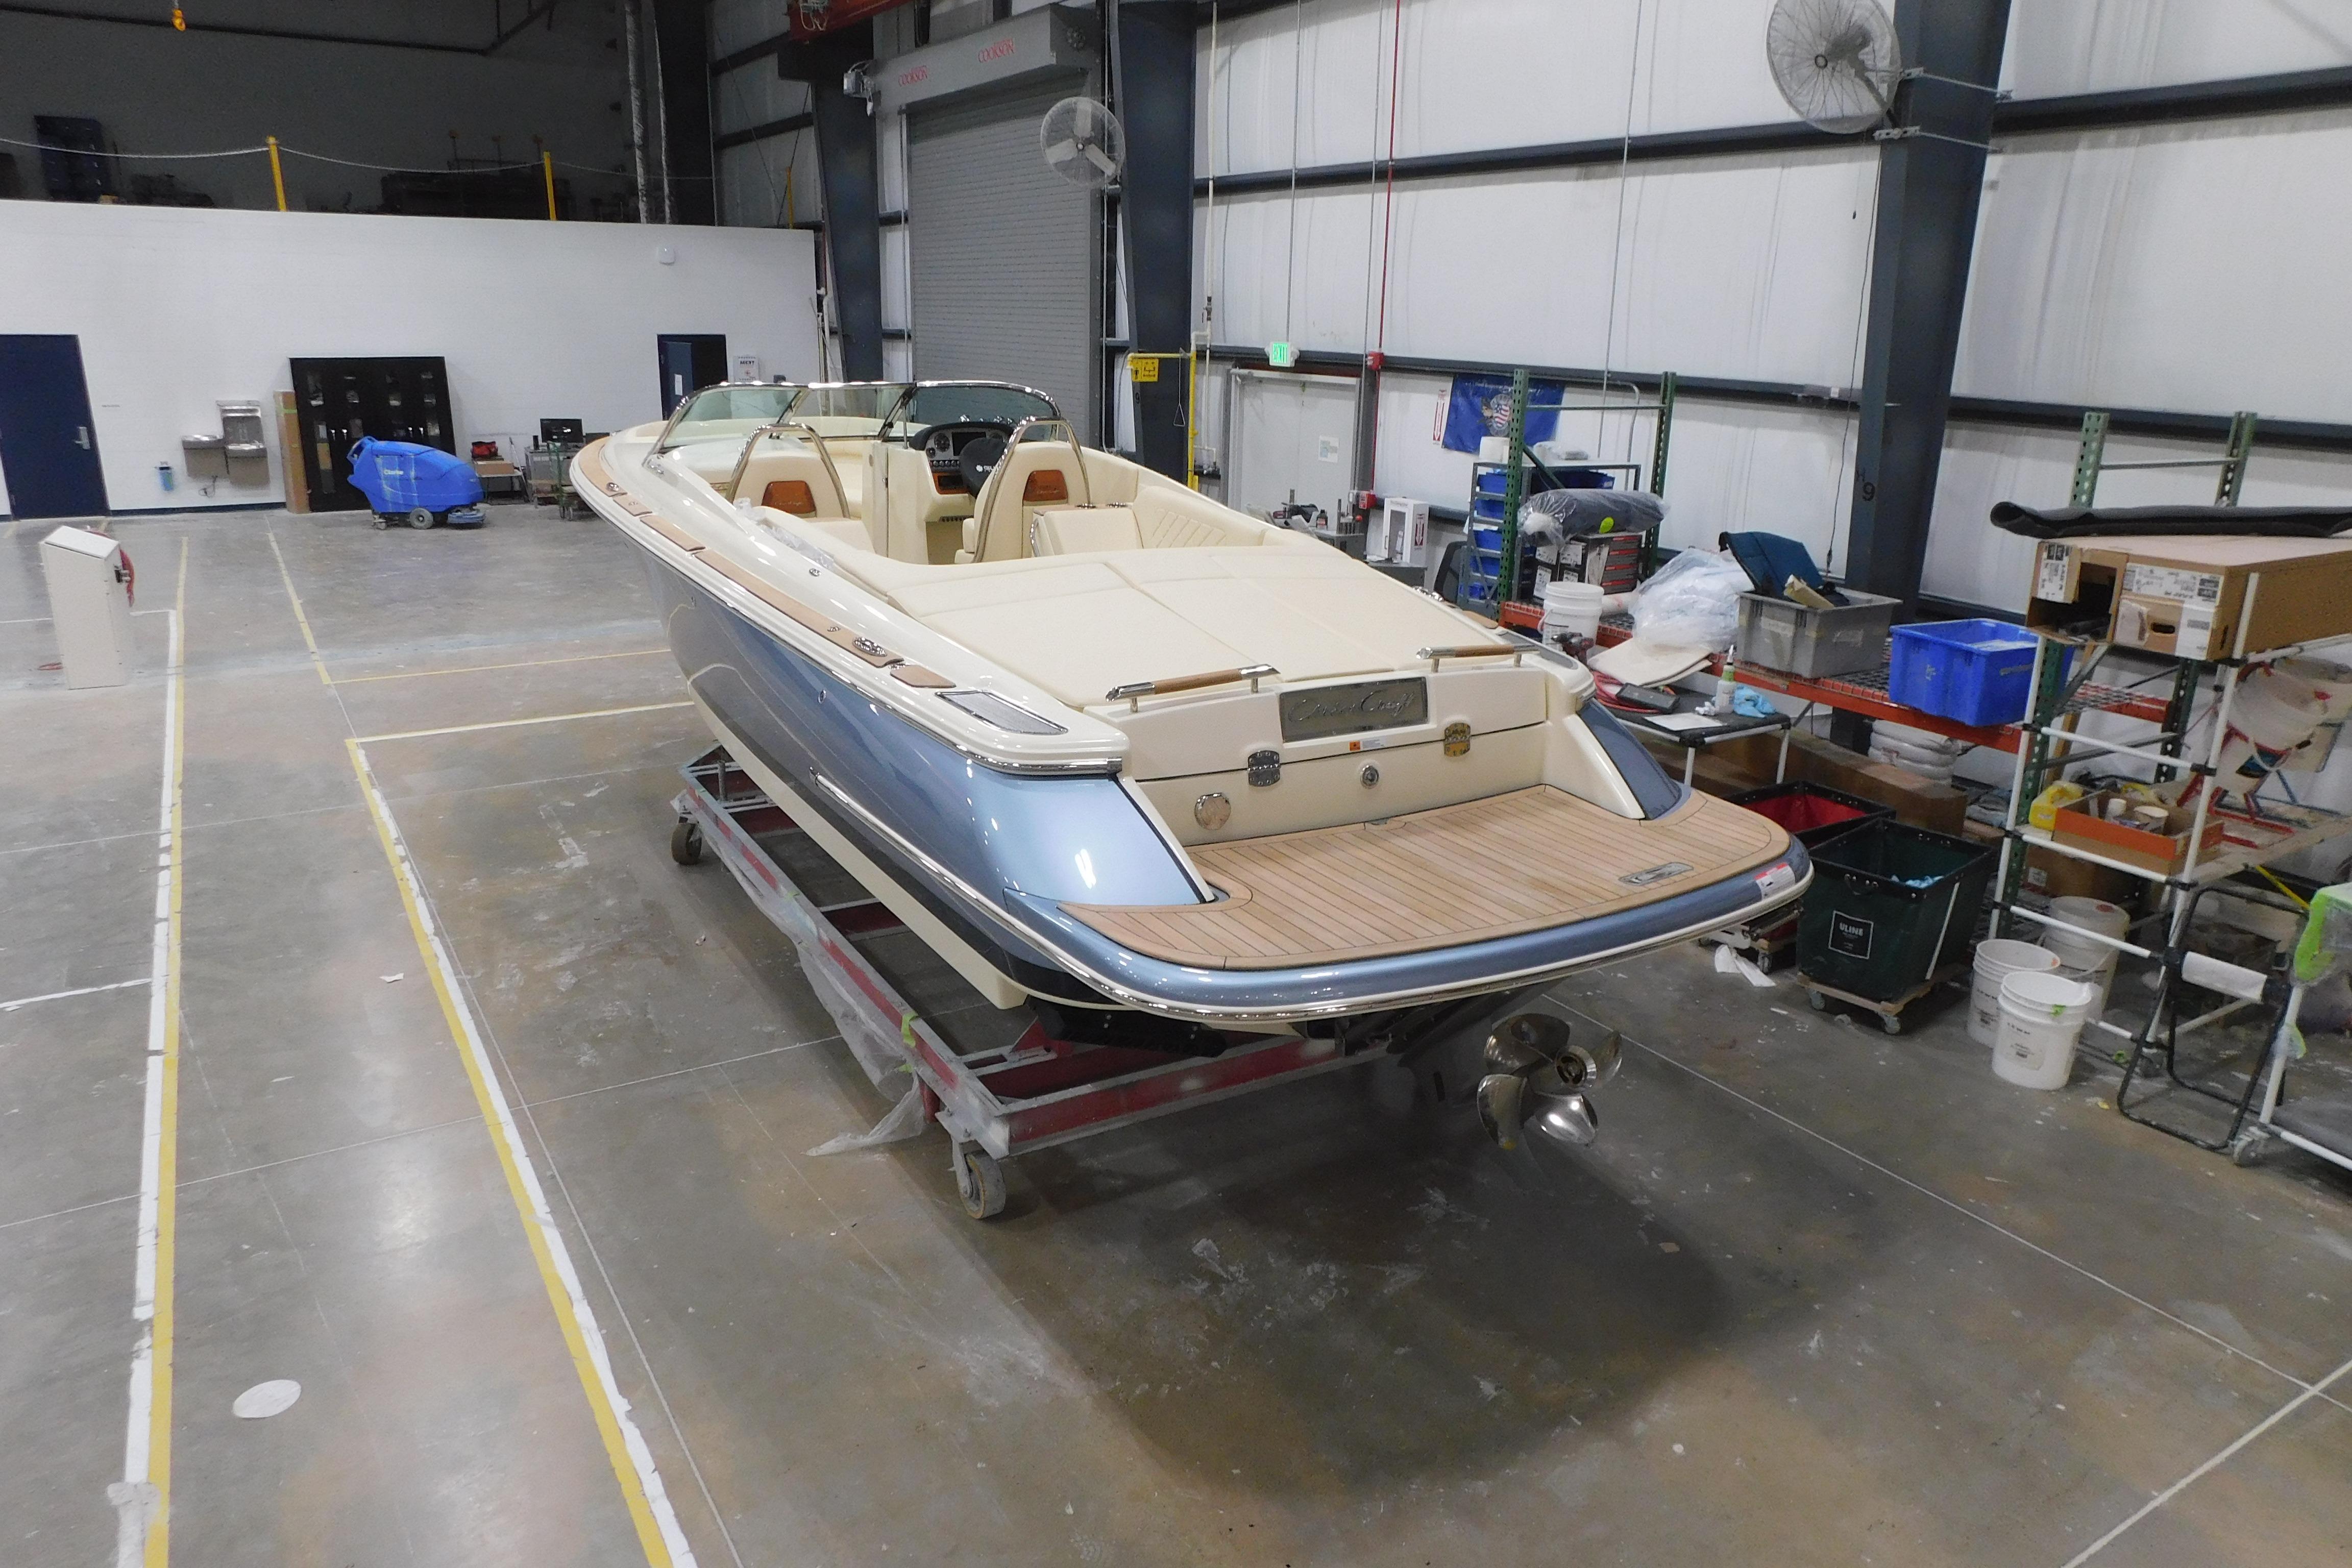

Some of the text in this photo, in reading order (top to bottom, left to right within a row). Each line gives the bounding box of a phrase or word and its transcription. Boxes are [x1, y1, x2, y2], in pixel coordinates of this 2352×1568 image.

[1273, 343, 1287, 363] EXIT
[1862, 481, 1875, 501] 9
[1839, 922, 1864, 937] ULINE
